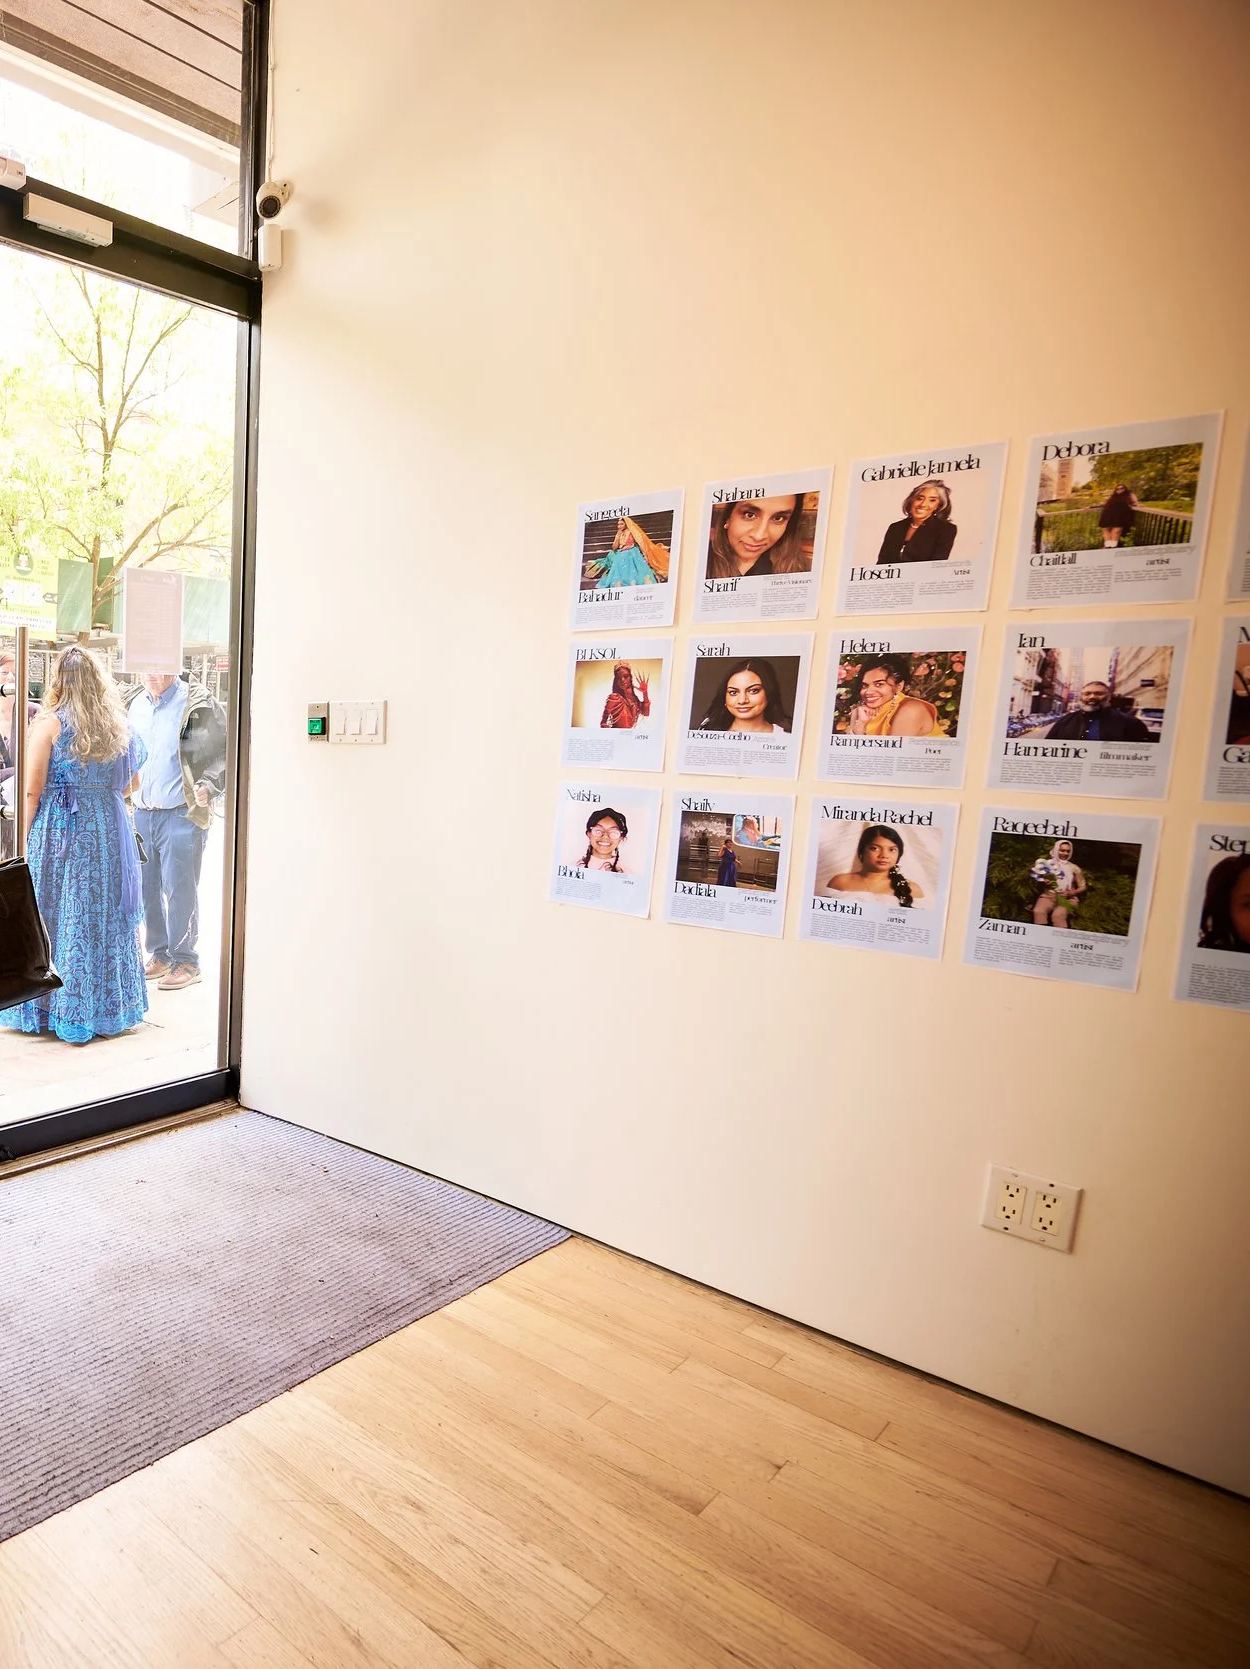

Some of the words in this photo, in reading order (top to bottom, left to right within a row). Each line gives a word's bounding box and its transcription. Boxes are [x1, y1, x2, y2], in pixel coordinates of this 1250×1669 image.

[1042, 441, 1110, 461] Debora
[861, 461, 926, 483] Gabrielle
[927, 454, 981, 477] Jamela
[712, 487, 765, 504] Shabana
[584, 505, 630, 521] Sangeeta
[850, 564, 901, 581] Hosein
[703, 578, 741, 593] Sharif
[578, 589, 624, 603] Bahadur
[840, 638, 891, 653] Helena
[1018, 633, 1045, 648] Ian
[576, 647, 621, 660] BLKSOL
[696, 643, 731, 656] Sarah
[687, 731, 751, 741] DeSouza-Coelho
[821, 805, 881, 823] Miranda
[883, 809, 933, 826] Rachel
[993, 816, 1078, 837] Raqeebah
[558, 865, 585, 880] Bhola
[811, 898, 863, 916] Deebrah
[978, 918, 1026, 936] Zaman
